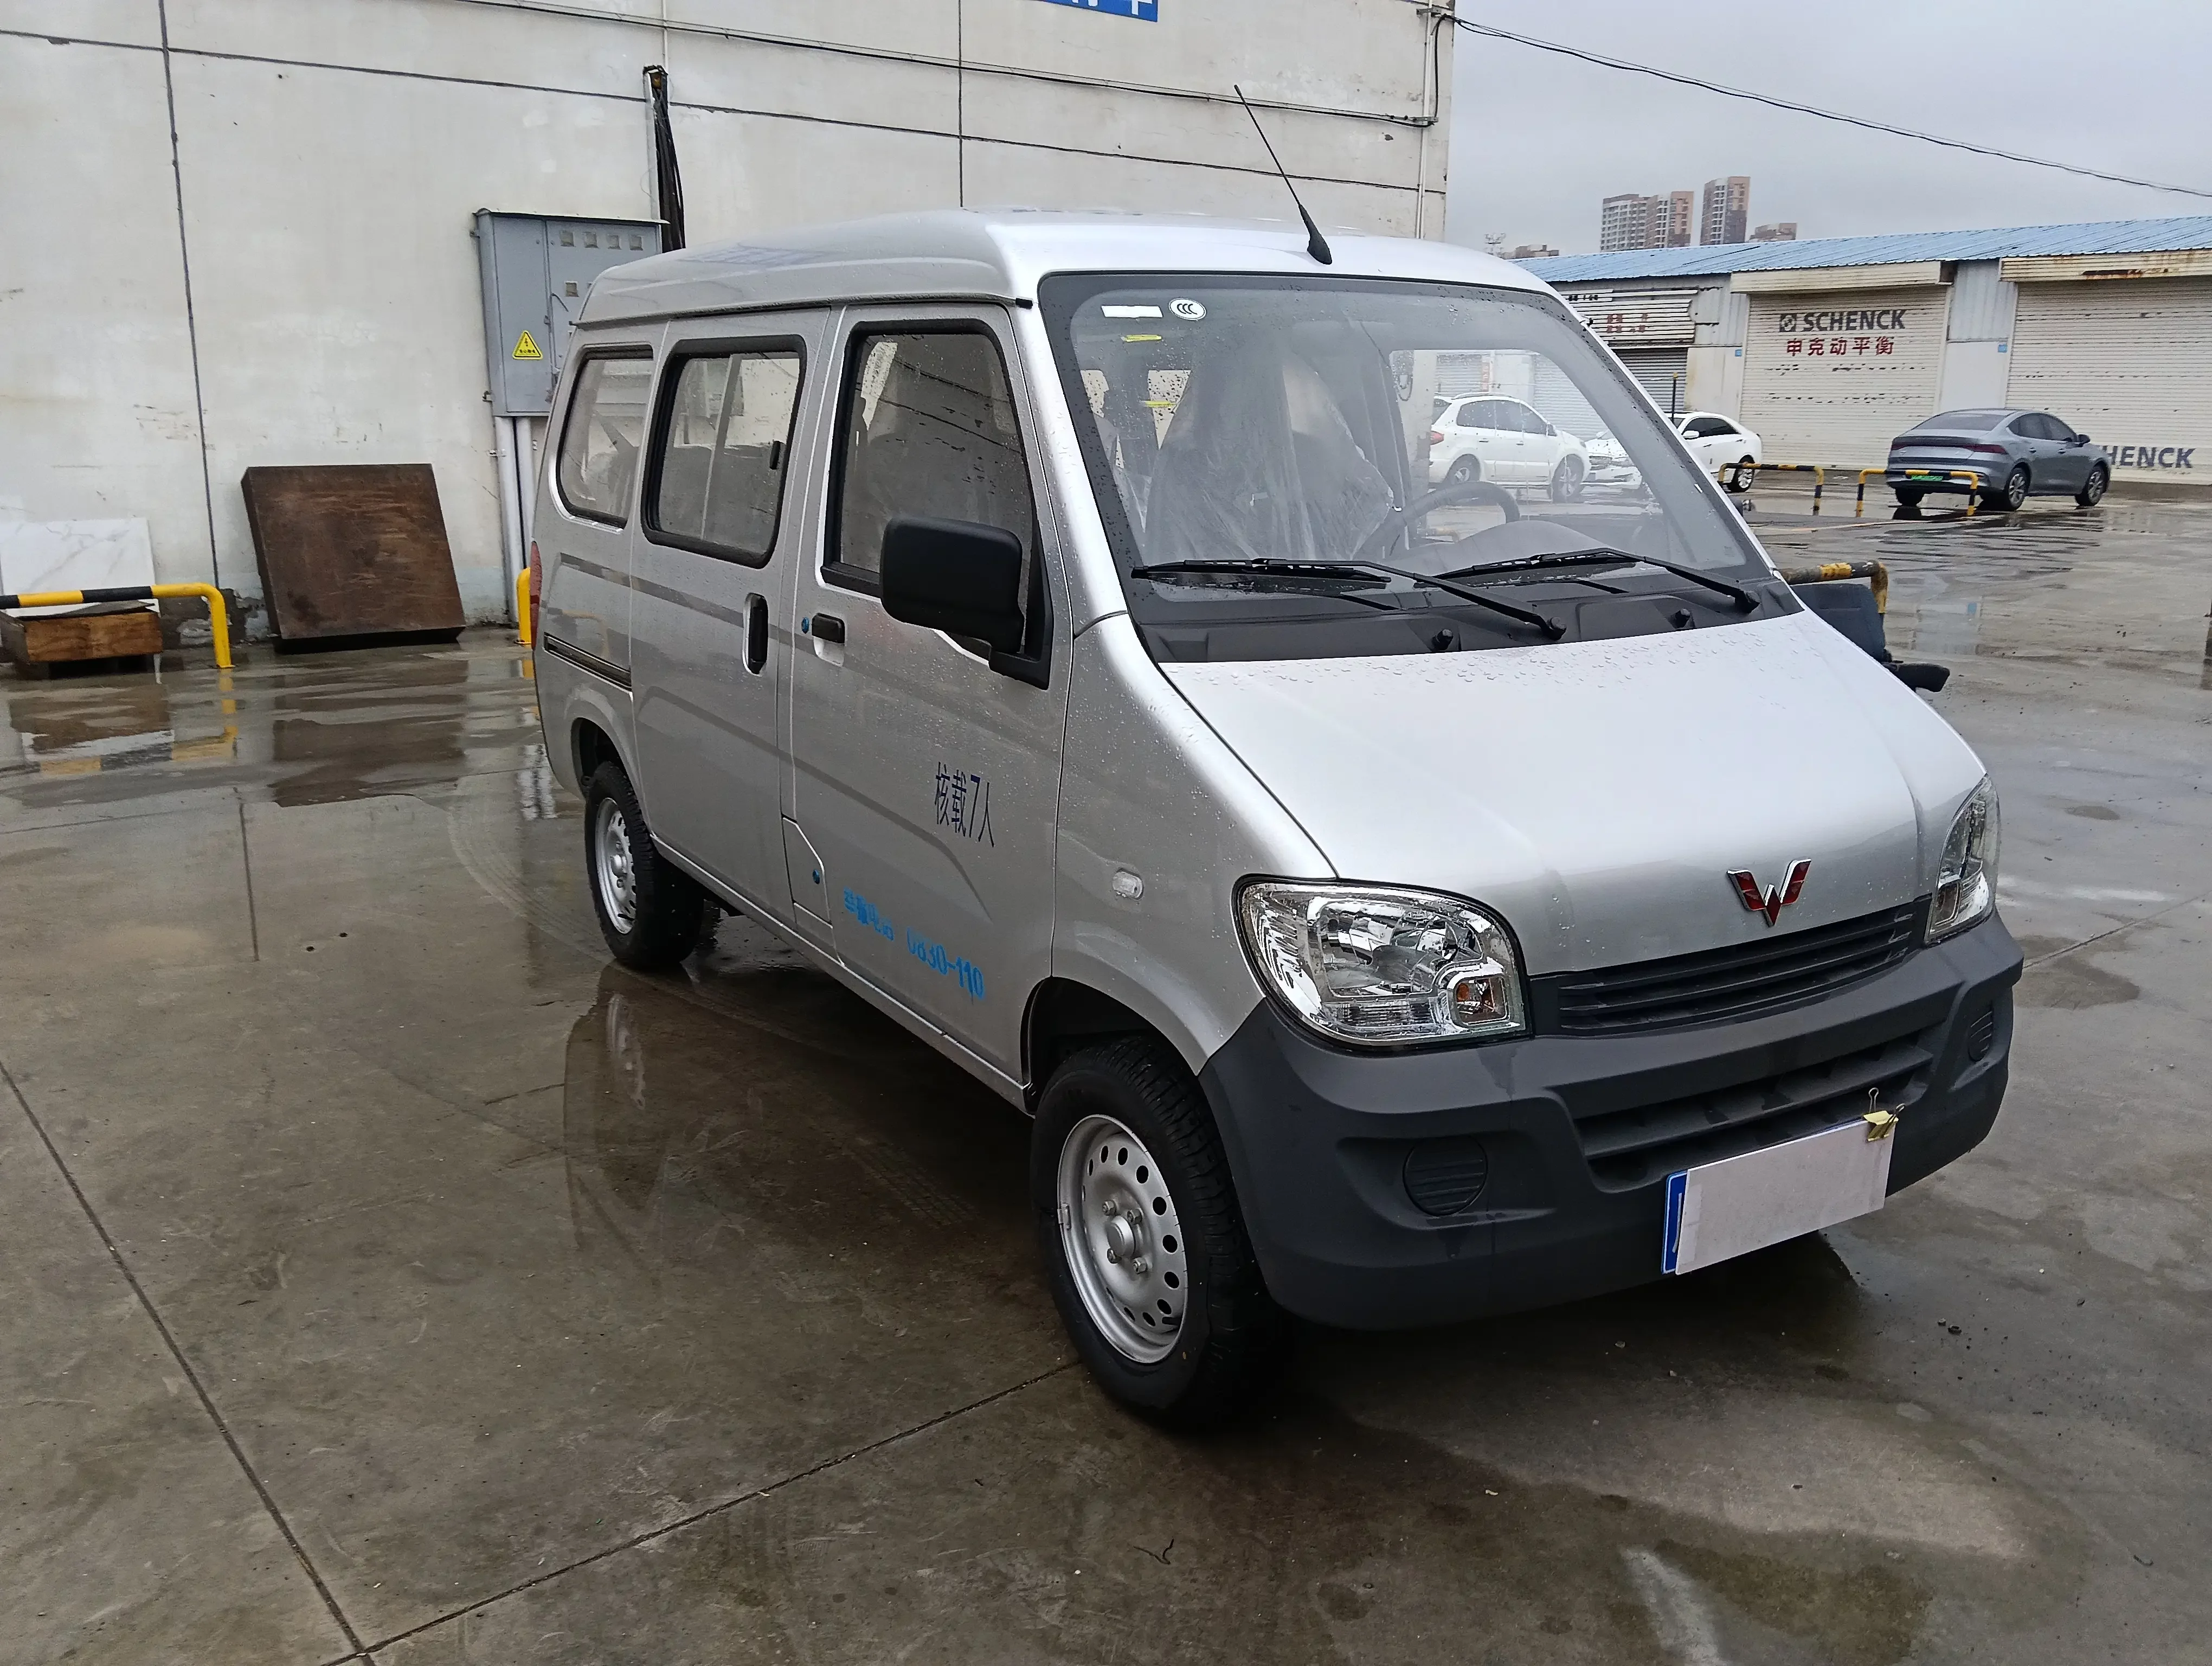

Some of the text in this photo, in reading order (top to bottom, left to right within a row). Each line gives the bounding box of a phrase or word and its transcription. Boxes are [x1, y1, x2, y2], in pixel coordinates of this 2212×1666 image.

[1802, 309, 1907, 332] SCHENCK
[1786, 336, 1895, 357] 申克动平衡
[2102, 445, 2196, 469] HENCK
[934, 761, 995, 848] 核载7人
